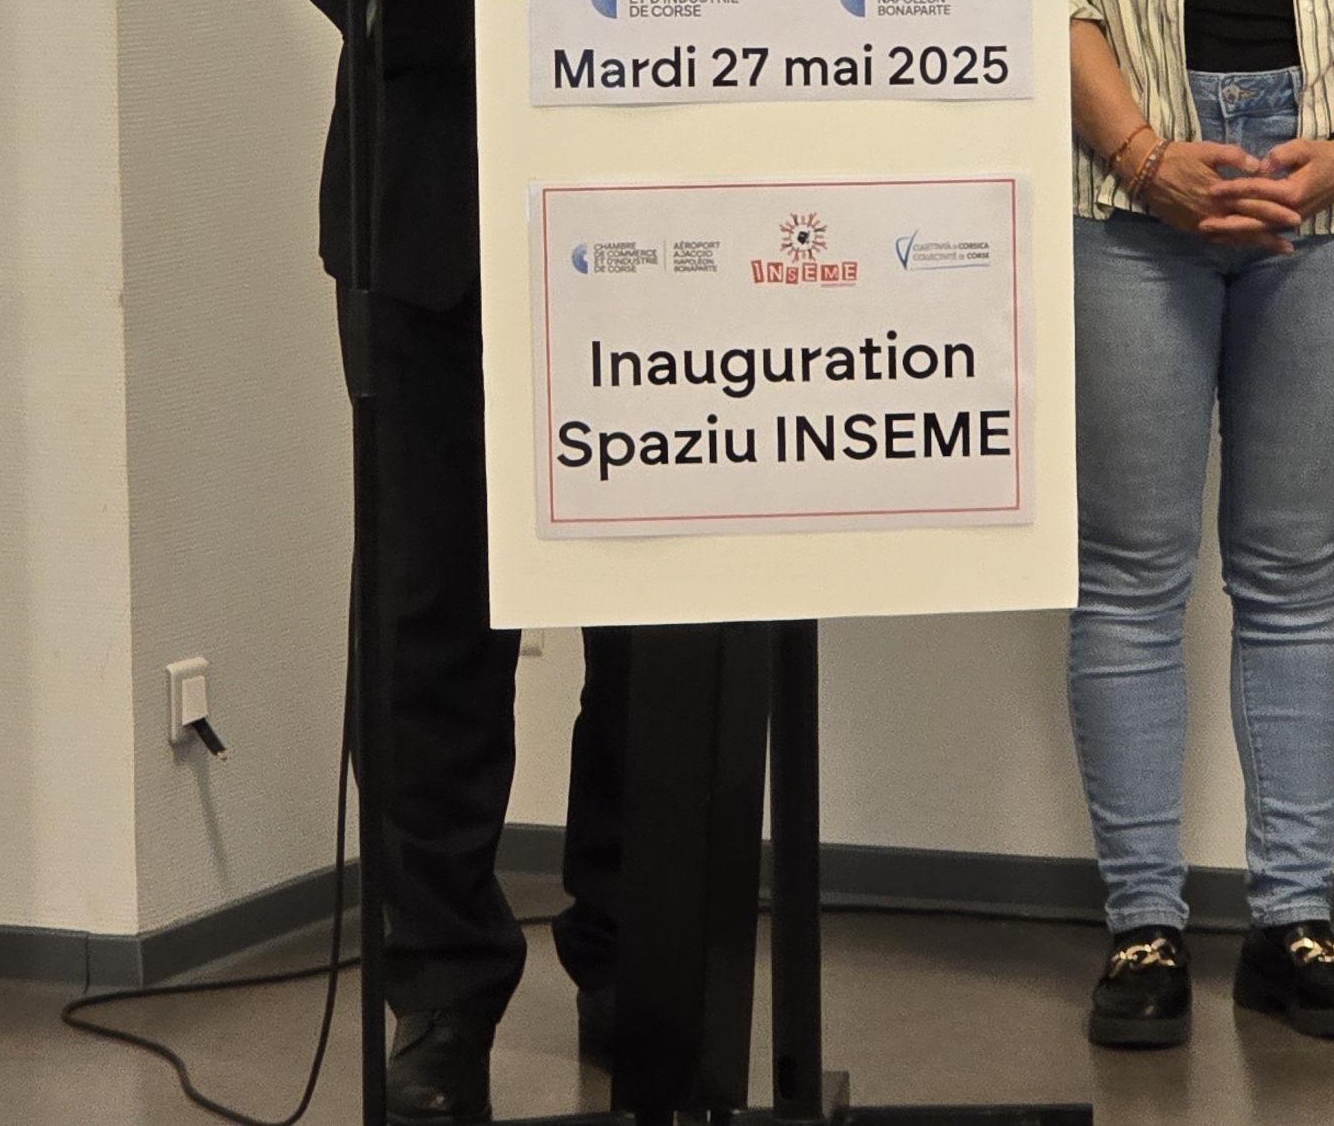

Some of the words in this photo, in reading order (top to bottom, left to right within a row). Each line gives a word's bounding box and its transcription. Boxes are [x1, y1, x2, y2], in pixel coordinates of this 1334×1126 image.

[629, 5, 648, 17] DE
[651, 5, 701, 17] CORSE
[878, 5, 951, 16] BONAPARTE
[553, 45, 696, 89] Mardi
[711, 47, 769, 87] 27
[784, 43, 872, 87] mai
[888, 45, 1009, 85] 2025
[751, 260, 857, 284] INSEME
[591, 330, 975, 398] Inauguration
[557, 414, 757, 481] Spaziu
[777, 410, 1011, 462] INSEME
